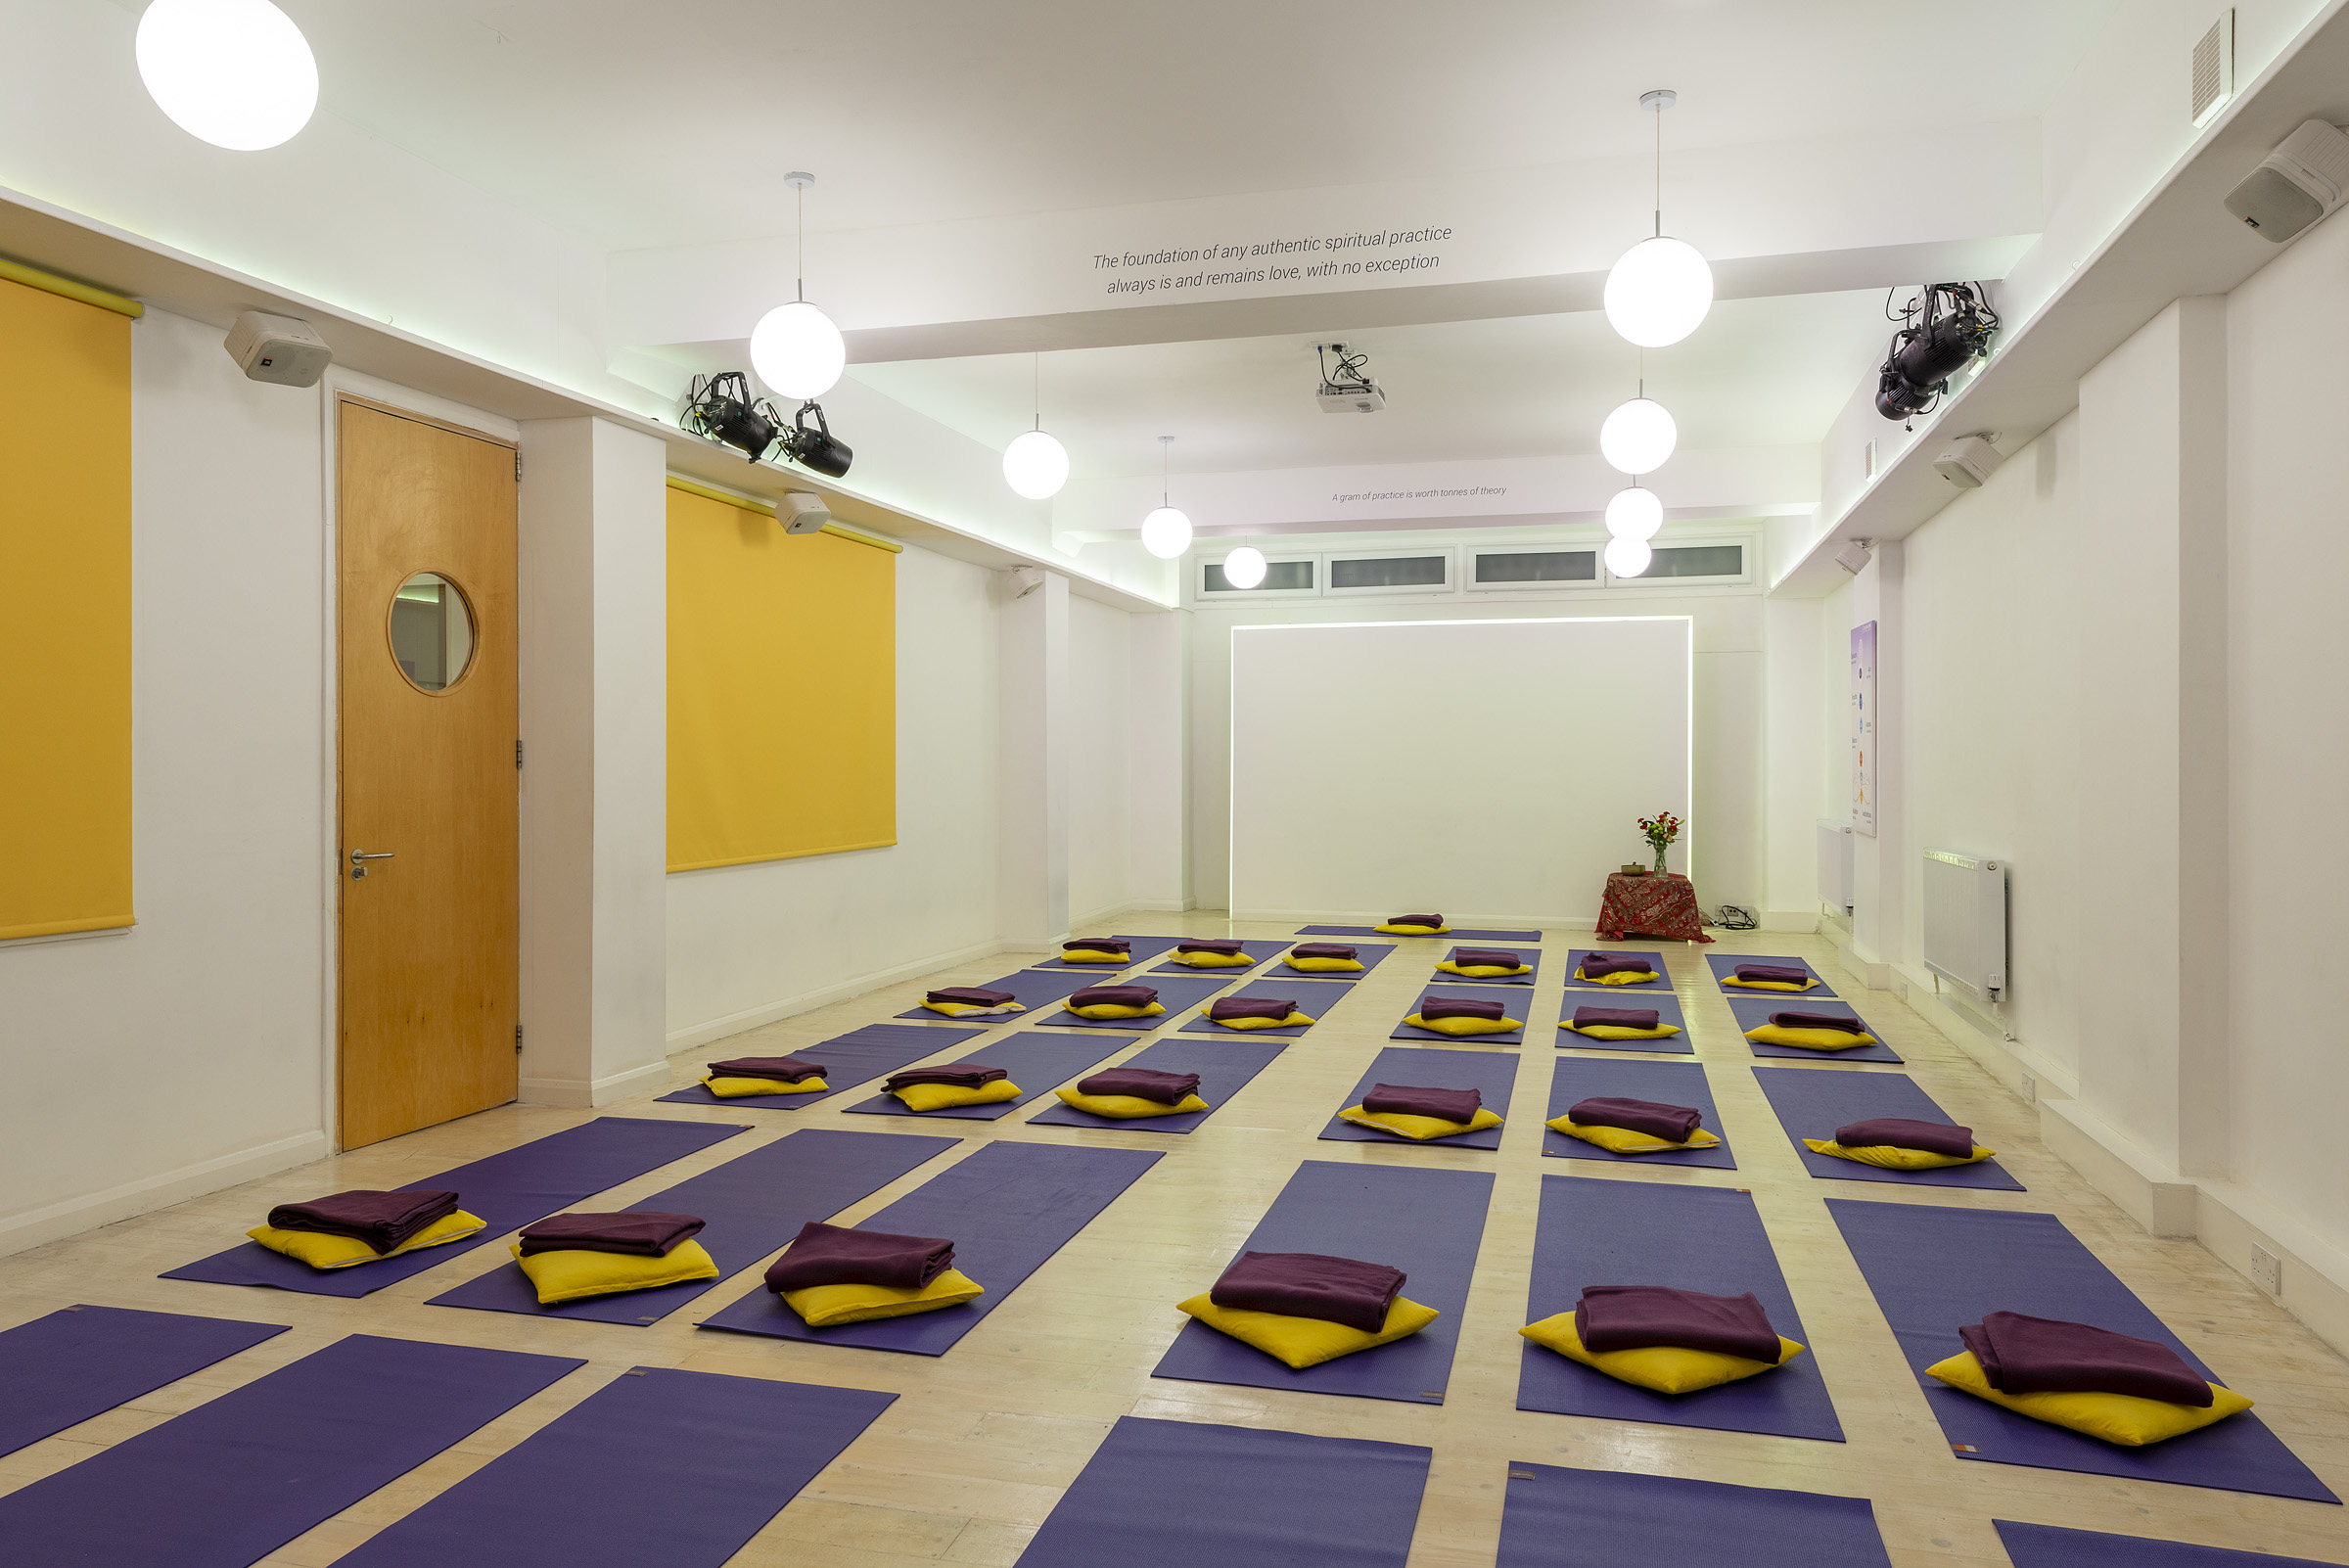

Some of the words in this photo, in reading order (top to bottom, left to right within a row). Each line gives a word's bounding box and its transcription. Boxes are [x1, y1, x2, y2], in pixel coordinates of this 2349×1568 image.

[1093, 254, 1119, 269] The
[1123, 248, 1199, 267] foundation
[1203, 244, 1220, 260] of
[1221, 245, 1248, 261] any
[1251, 236, 1321, 256] authentic
[1324, 230, 1386, 252] spiritual
[1389, 225, 1452, 248] practice
[1107, 277, 1156, 296] always
[1160, 274, 1173, 290] is
[1175, 271, 1203, 288] and
[1206, 267, 1266, 286] remains
[1268, 264, 1302, 281] love,
[1307, 259, 1338, 278] with
[1342, 261, 1361, 275] no
[1365, 254, 1440, 274] exception
[1332, 493, 1338, 502] A
[1340, 493, 1361, 503] gram
[1362, 491, 1372, 501] of
[1372, 490, 1405, 501] practice
[1415, 488, 1439, 498] worth
[1441, 487, 1468, 497] tonnes
[1470, 486, 1480, 496] of
[1480, 485, 1507, 496] theory
